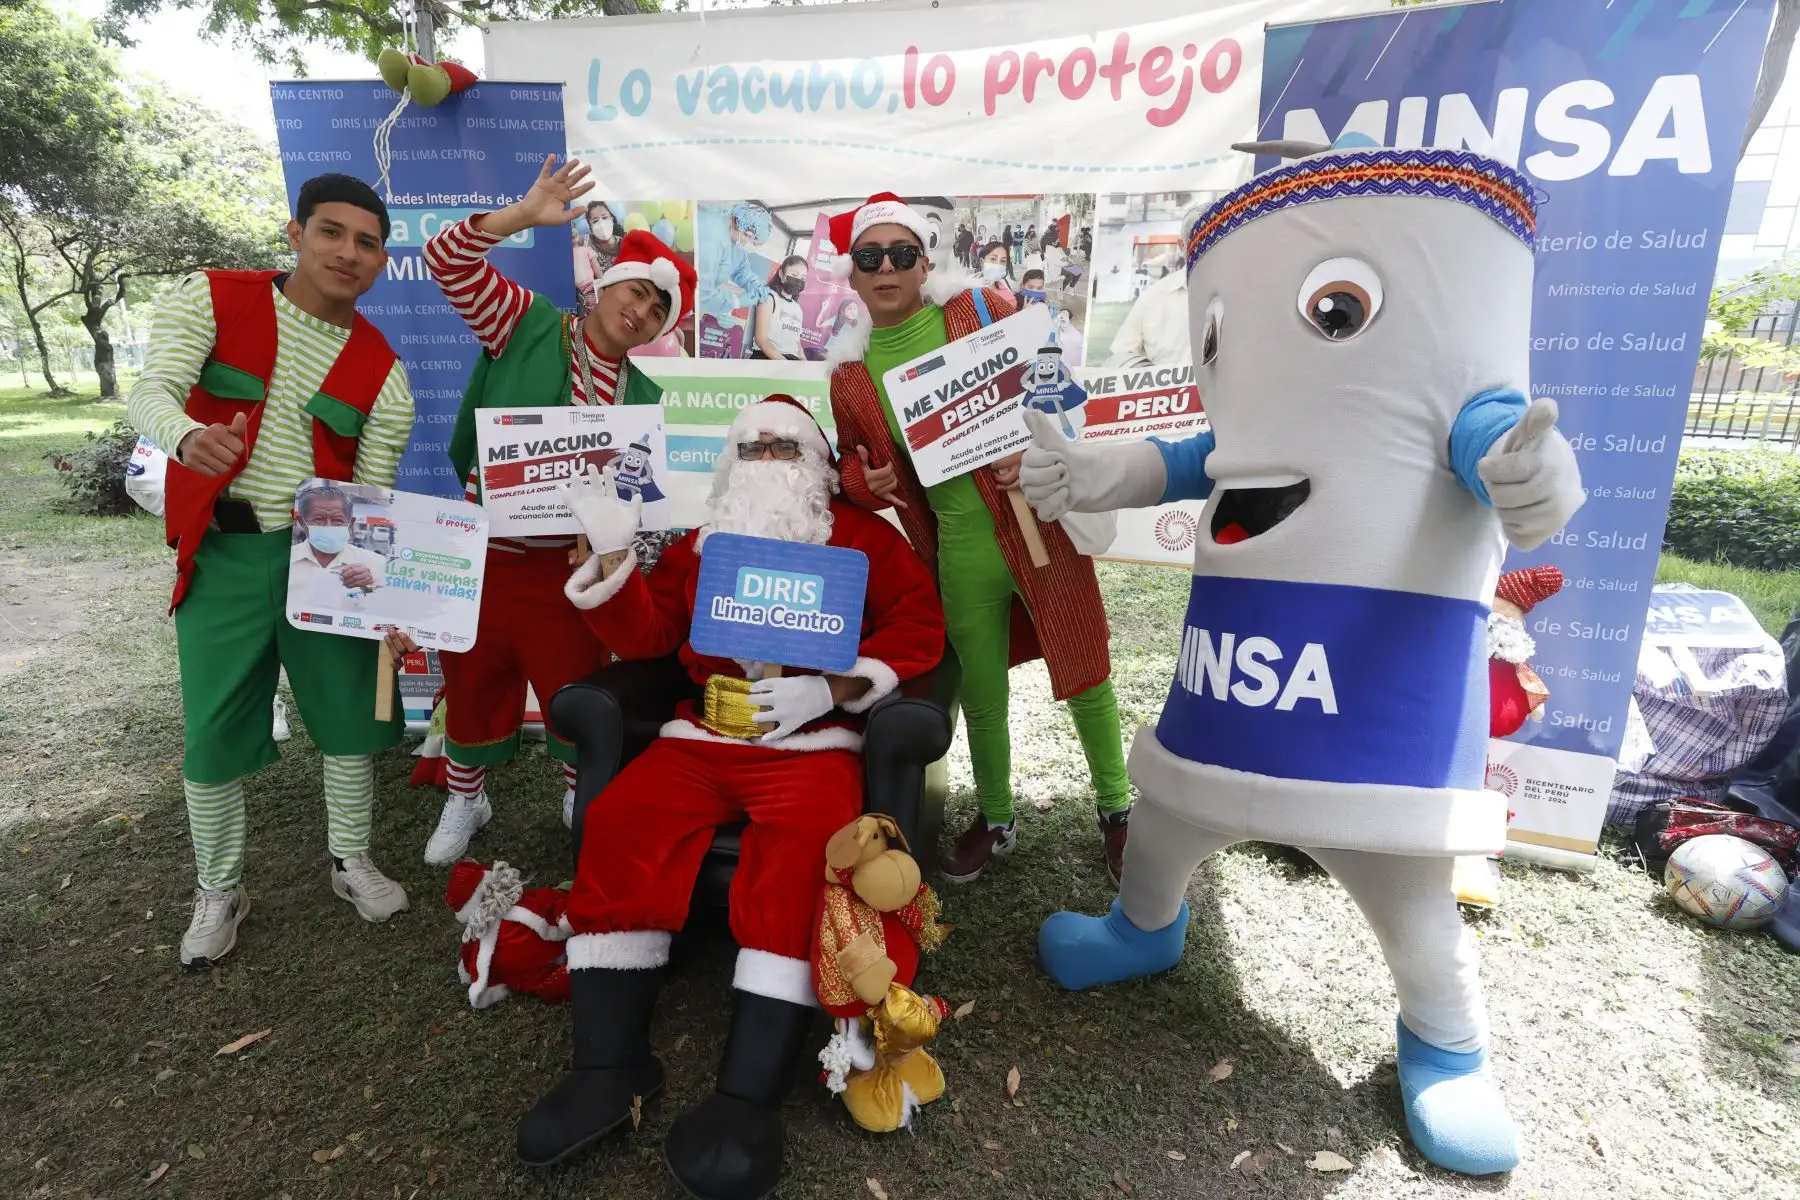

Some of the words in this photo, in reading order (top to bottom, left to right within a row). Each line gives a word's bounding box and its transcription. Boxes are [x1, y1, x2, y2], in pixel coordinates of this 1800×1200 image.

[587, 57, 651, 121] Lo
[676, 56, 899, 115] vacuno,
[903, 46, 956, 109] lo
[984, 32, 1242, 128] protejo
[272, 89, 296, 100] IMA
[299, 89, 343, 100] CENTRO
[510, 89, 539, 100] DIRIS
[542, 91, 562, 101] LIM
[332, 118, 360, 129] DIRIS
[467, 117, 496, 129] DIRIS
[500, 119, 528, 130] LIMA
[531, 120, 565, 131] CENTR
[282, 151, 305, 162] IMA
[308, 151, 352, 162] CENTRO
[412, 150, 438, 161] LIMA
[441, 150, 486, 161] CENTRO
[516, 152, 544, 163] DIRIS
[386, 191, 424, 205] Redes
[427, 191, 493, 206] Integradas
[496, 193, 513, 206] de
[1604, 230, 1633, 250] de
[1639, 228, 1708, 249] Salud
[1548, 283, 1625, 297] Ministerio
[1629, 283, 1649, 296] de
[1653, 282, 1697, 296] Salud
[356, 305, 384, 315] DIRIS
[387, 305, 412, 315] LIMA
[415, 305, 456, 315] CENTRO
[401, 335, 429, 345] DIRIS
[431, 335, 457, 345] LIMA
[459, 334, 479, 344] CEN
[1587, 332, 1614, 351] de
[1620, 332, 1687, 352] Salud
[421, 361, 461, 370] CENTRO
[903, 394, 934, 423] ME
[934, 346, 1019, 403] VACUNO
[1083, 375, 1117, 395] ME
[1123, 366, 1195, 391] VACU
[438, 390, 462, 399] LIMA
[1036, 386, 1060, 396] MINSA
[1531, 383, 1608, 397] Ministerio
[1611, 383, 1630, 397] de
[1633, 384, 1677, 398] Salud
[941, 380, 1001, 431] PERÚ
[1117, 388, 1190, 420] PERÚ
[942, 423, 980, 448] COMPLETA
[981, 414, 996, 427] TUS
[996, 401, 1019, 419] DOSIS
[1084, 427, 1130, 439] COMPLETA
[1145, 422, 1173, 431] DOSIS
[1175, 420, 1194, 429] QUE
[1196, 418, 1207, 426] TE
[414, 443, 440, 452] DIRIS
[488, 444, 519, 462] ME
[524, 431, 612, 457] VACUNO
[950, 448, 974, 461] Acude
[984, 435, 1008, 448] centro
[1009, 429, 1019, 438] de
[1569, 433, 1597, 451] de
[1602, 434, 1667, 453] Salud
[668, 449, 720, 465] centr
[941, 454, 984, 474] vacunación
[985, 446, 1002, 457] más
[406, 467, 430, 476] LIMA
[523, 453, 586, 483] PERÚ
[489, 490, 525, 500] COMPLETA
[536, 485, 557, 493] DOSIS
[1593, 486, 1612, 498] de
[1614, 487, 1657, 500] Salud
[436, 516, 443, 524] lo
[445, 519, 476, 532] protejo
[509, 512, 554, 520] vacunación
[1550, 528, 1579, 546] de
[1584, 531, 1647, 551] Salud
[421, 569, 478, 588] vacunas
[1576, 577, 1594, 589] de
[1598, 578, 1639, 592] Salud
[385, 576, 431, 594] salvan
[437, 584, 478, 601] vidas!
[743, 574, 817, 605] DIRIS
[713, 598, 764, 623] Lima
[770, 606, 842, 632] Centro
[1533, 617, 1562, 635] de
[1567, 621, 1630, 642] Salud
[406, 657, 424, 666] PERÚ
[1558, 666, 1577, 678] de
[1581, 669, 1621, 683] Salud
[1550, 710, 1612, 732] Salud
[1525, 785, 1542, 794] DEL
[1545, 788, 1569, 798] PERÚ
[1526, 778, 1595, 794] BICENTENARIO
[1524, 792, 1540, 800] 2021
[1548, 796, 1567, 804] 2024
